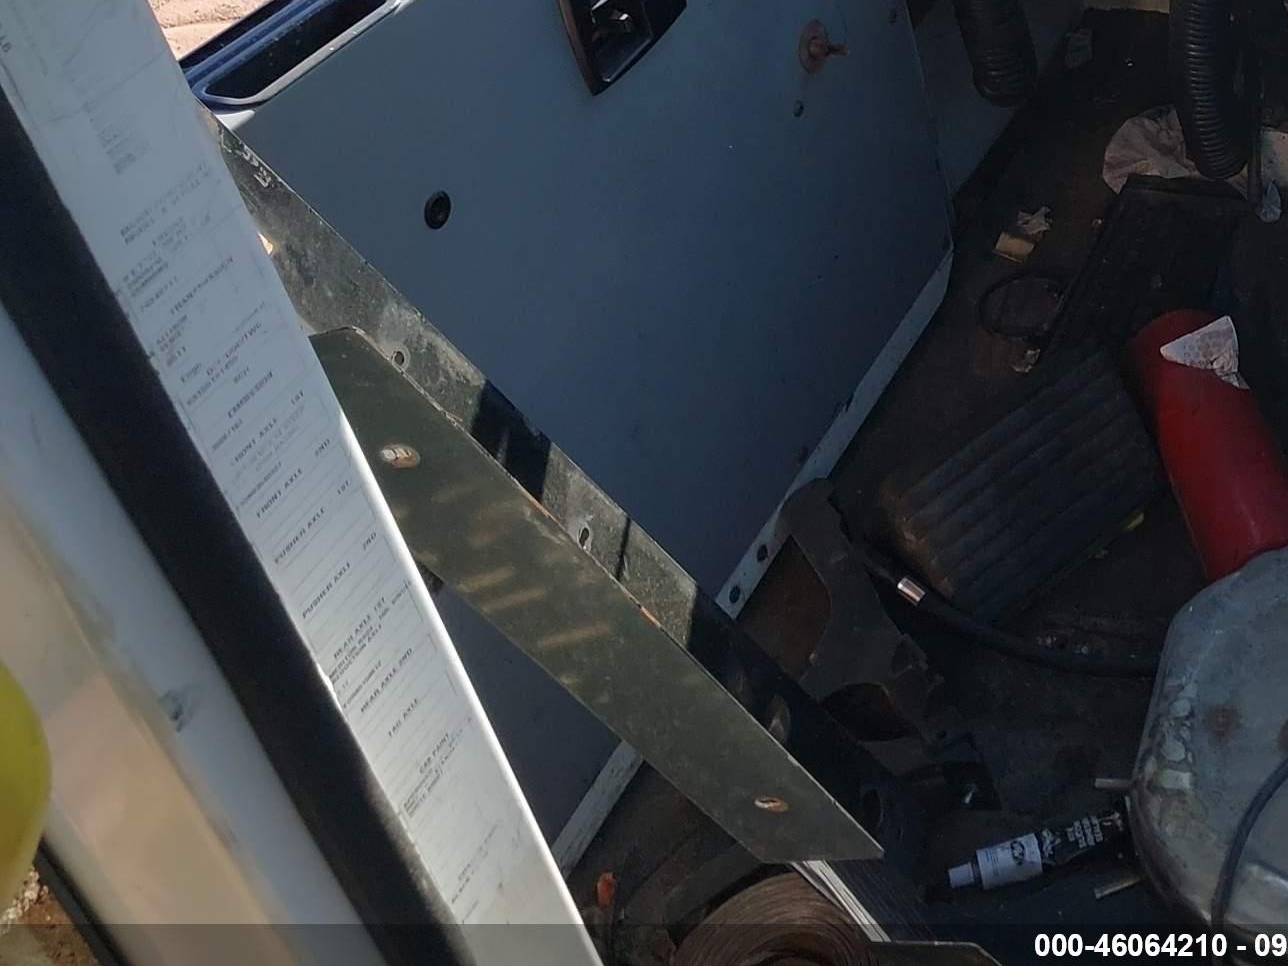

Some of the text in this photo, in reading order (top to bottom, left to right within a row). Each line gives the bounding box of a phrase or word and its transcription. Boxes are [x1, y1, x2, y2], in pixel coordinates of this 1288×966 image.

[282, 466, 302, 490] AXLE
[306, 504, 326, 529] AXLE
[332, 560, 350, 583] AXLE
[353, 612, 371, 635] AXLE
[379, 665, 397, 689] AXLE
[401, 696, 419, 720] AXLE
